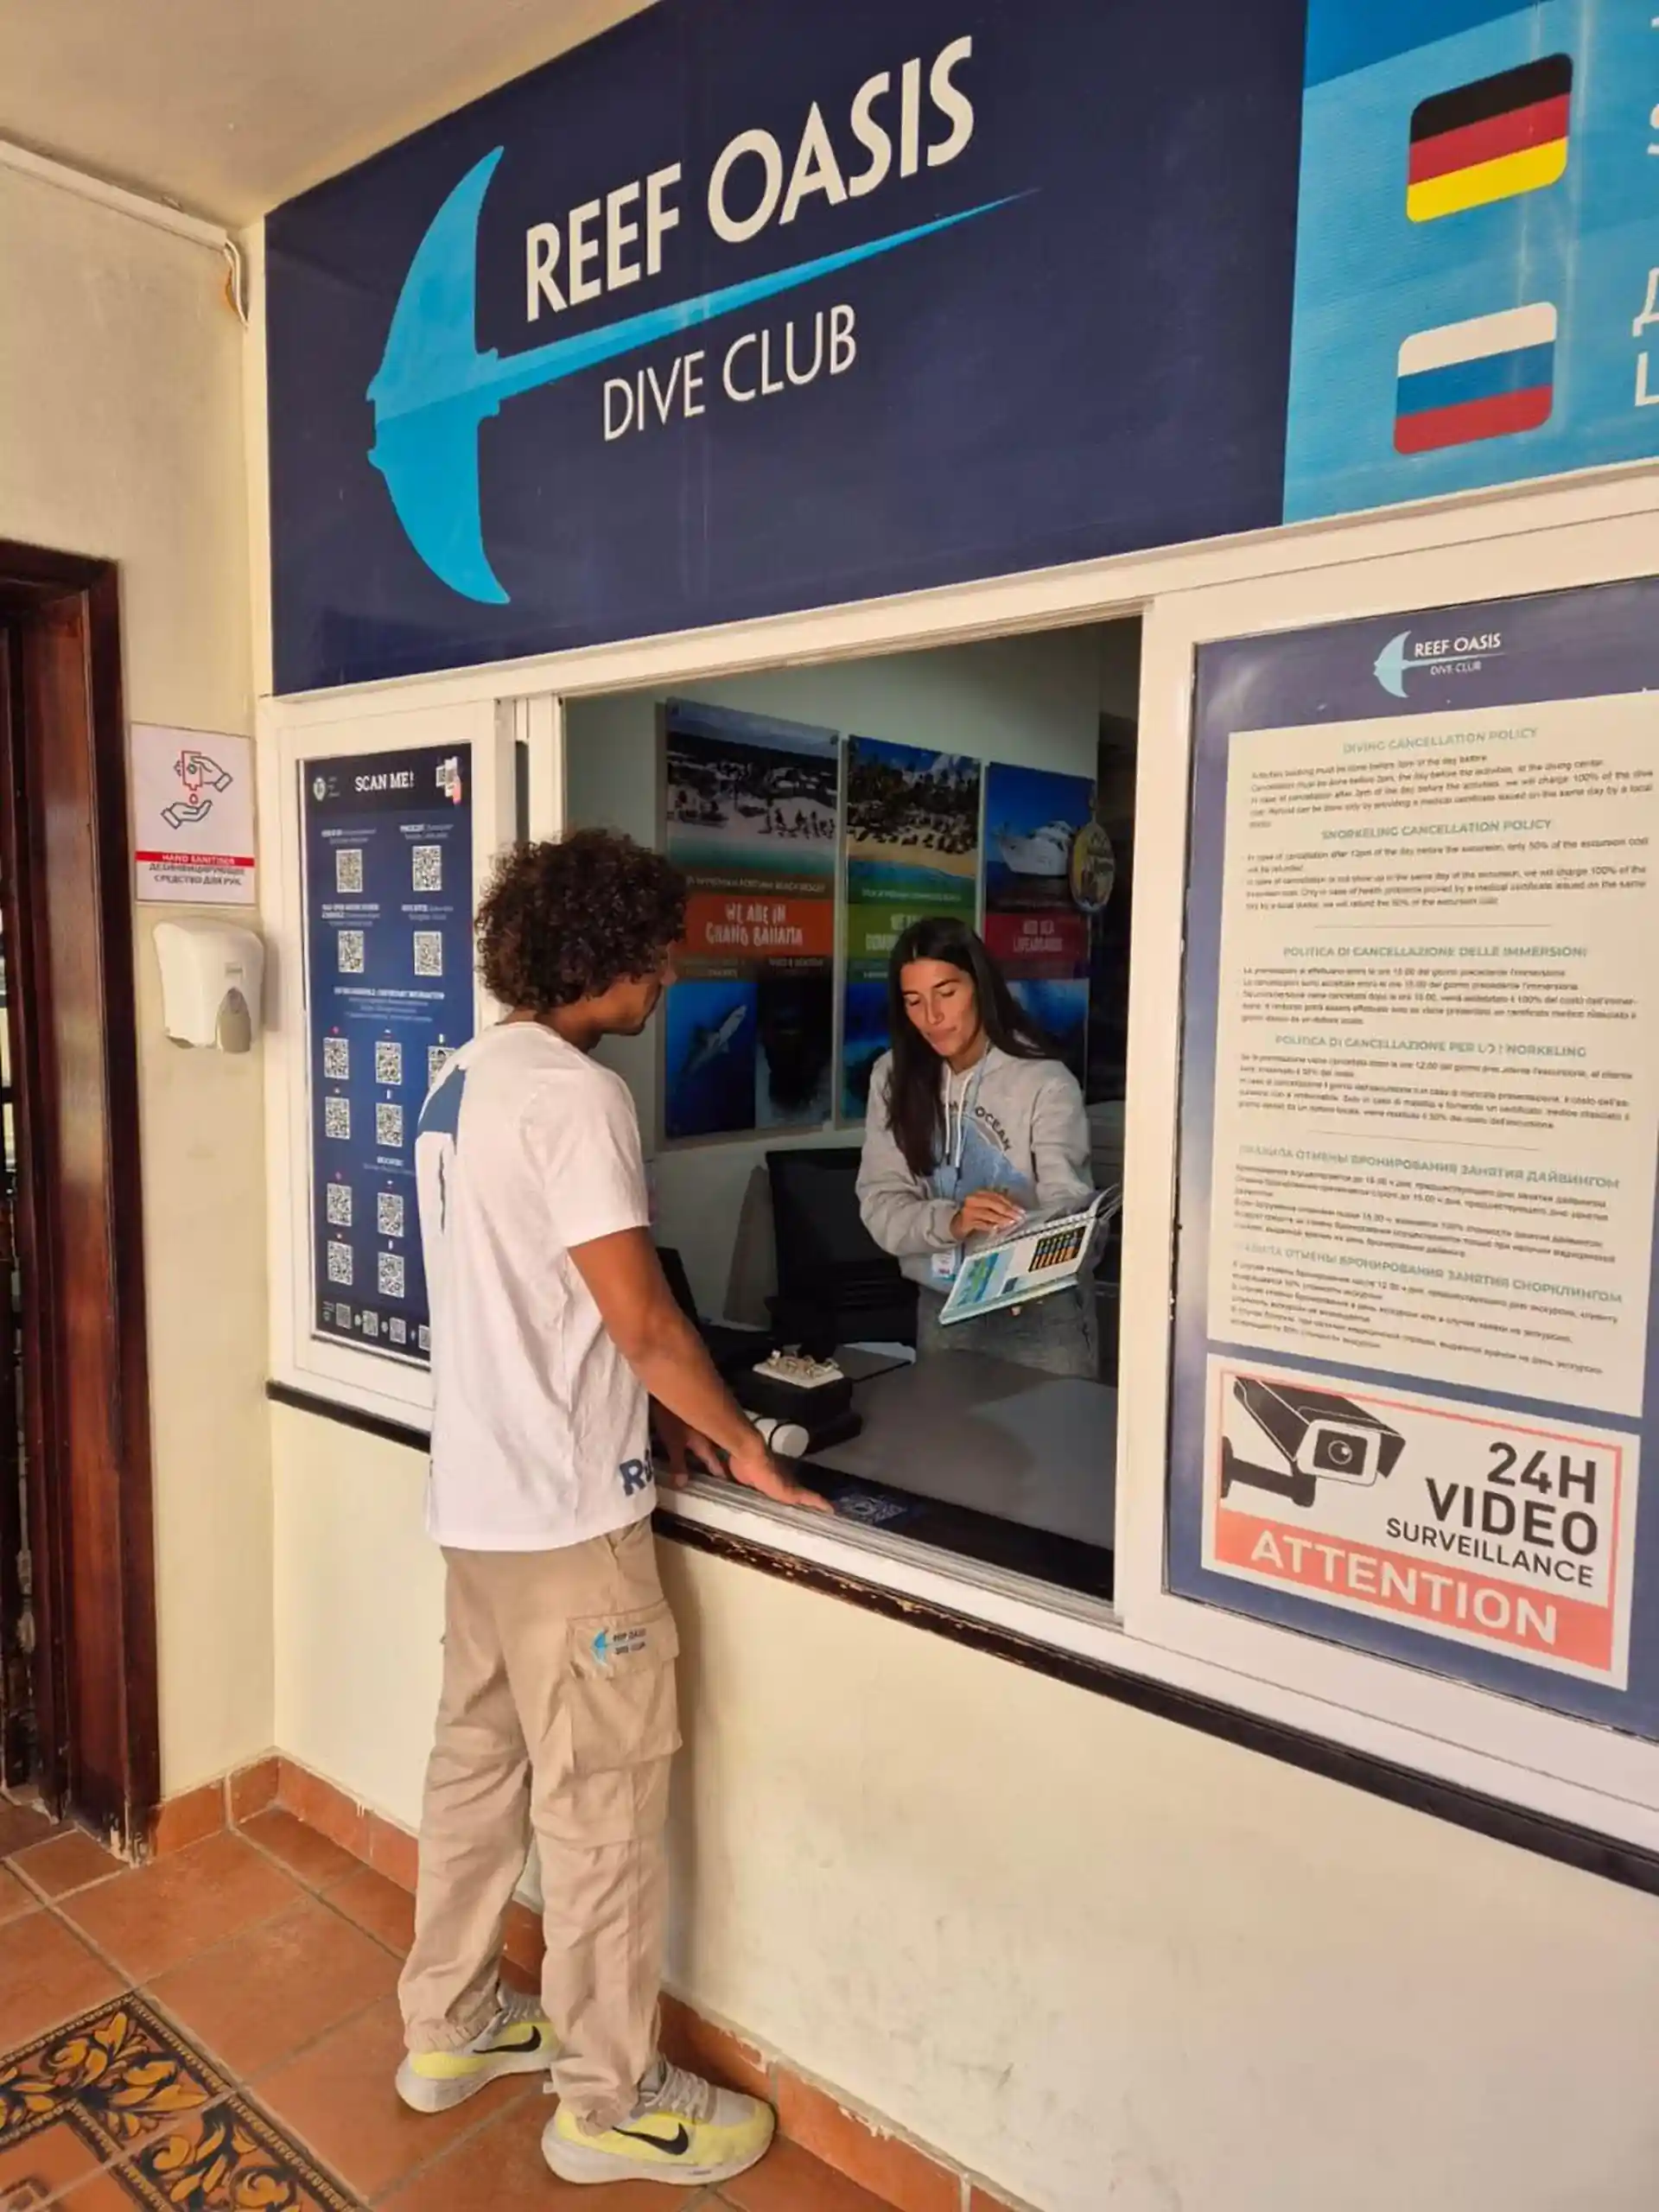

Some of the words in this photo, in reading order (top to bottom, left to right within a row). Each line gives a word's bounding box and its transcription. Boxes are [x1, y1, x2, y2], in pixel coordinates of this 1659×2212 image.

[525, 161, 682, 322] REEF
[707, 35, 975, 244] OASIS
[603, 349, 705, 442] DIVE
[721, 303, 857, 403] CLUB
[1414, 639, 1450, 658] REEF
[1453, 632, 1502, 652] OASIS
[1455, 660, 1482, 673] CLUB
[1343, 740, 1386, 755] DIVING
[1388, 732, 1486, 751] CANCELLATION
[1488, 727, 1538, 741] POLICY
[354, 774, 387, 792] SCAN
[389, 771, 416, 790] ME!
[1321, 825, 1399, 841] SNORKELING
[1400, 820, 1500, 837] CANCELLATION
[1503, 818, 1552, 831] POLICY
[162, 854, 188, 862] HAND
[724, 901, 744, 925] WE
[745, 901, 769, 925] ARE
[1283, 945, 1336, 958] POLITICA
[1338, 946, 1351, 957] DI
[1352, 945, 1456, 958] CANCELLAZIONE
[1459, 945, 1500, 957] DELLE
[1329, 1037, 1343, 1048] DI
[1344, 1037, 1446, 1052] CANCELLAZIONE
[1448, 1041, 1475, 1053] PER
[974, 1105, 1013, 1153] OCEAN
[1296, 1149, 1348, 1164] ОТМЕНЫ
[1350, 1154, 1459, 1175] БРОНИРОВАНИЯ
[1460, 1164, 1524, 1181] ЗАНЯТИЯ
[1526, 1168, 1620, 1190] ДАЙВИНГОМ
[1286, 1248, 1338, 1264] ОТМЕНЫ
[1339, 1255, 1445, 1279] БРОНИРОВАНИЯ
[1447, 1269, 1510, 1289] ЗАНЯТИЯ
[1512, 1279, 1624, 1304] СНОРКЛИНГОМ
[1486, 1440, 1598, 1506] 24H
[1425, 1477, 1599, 1557] VIDEO
[1384, 1516, 1595, 1590] SURVEILLANCE
[1249, 1529, 1558, 1648] ATTENTION
